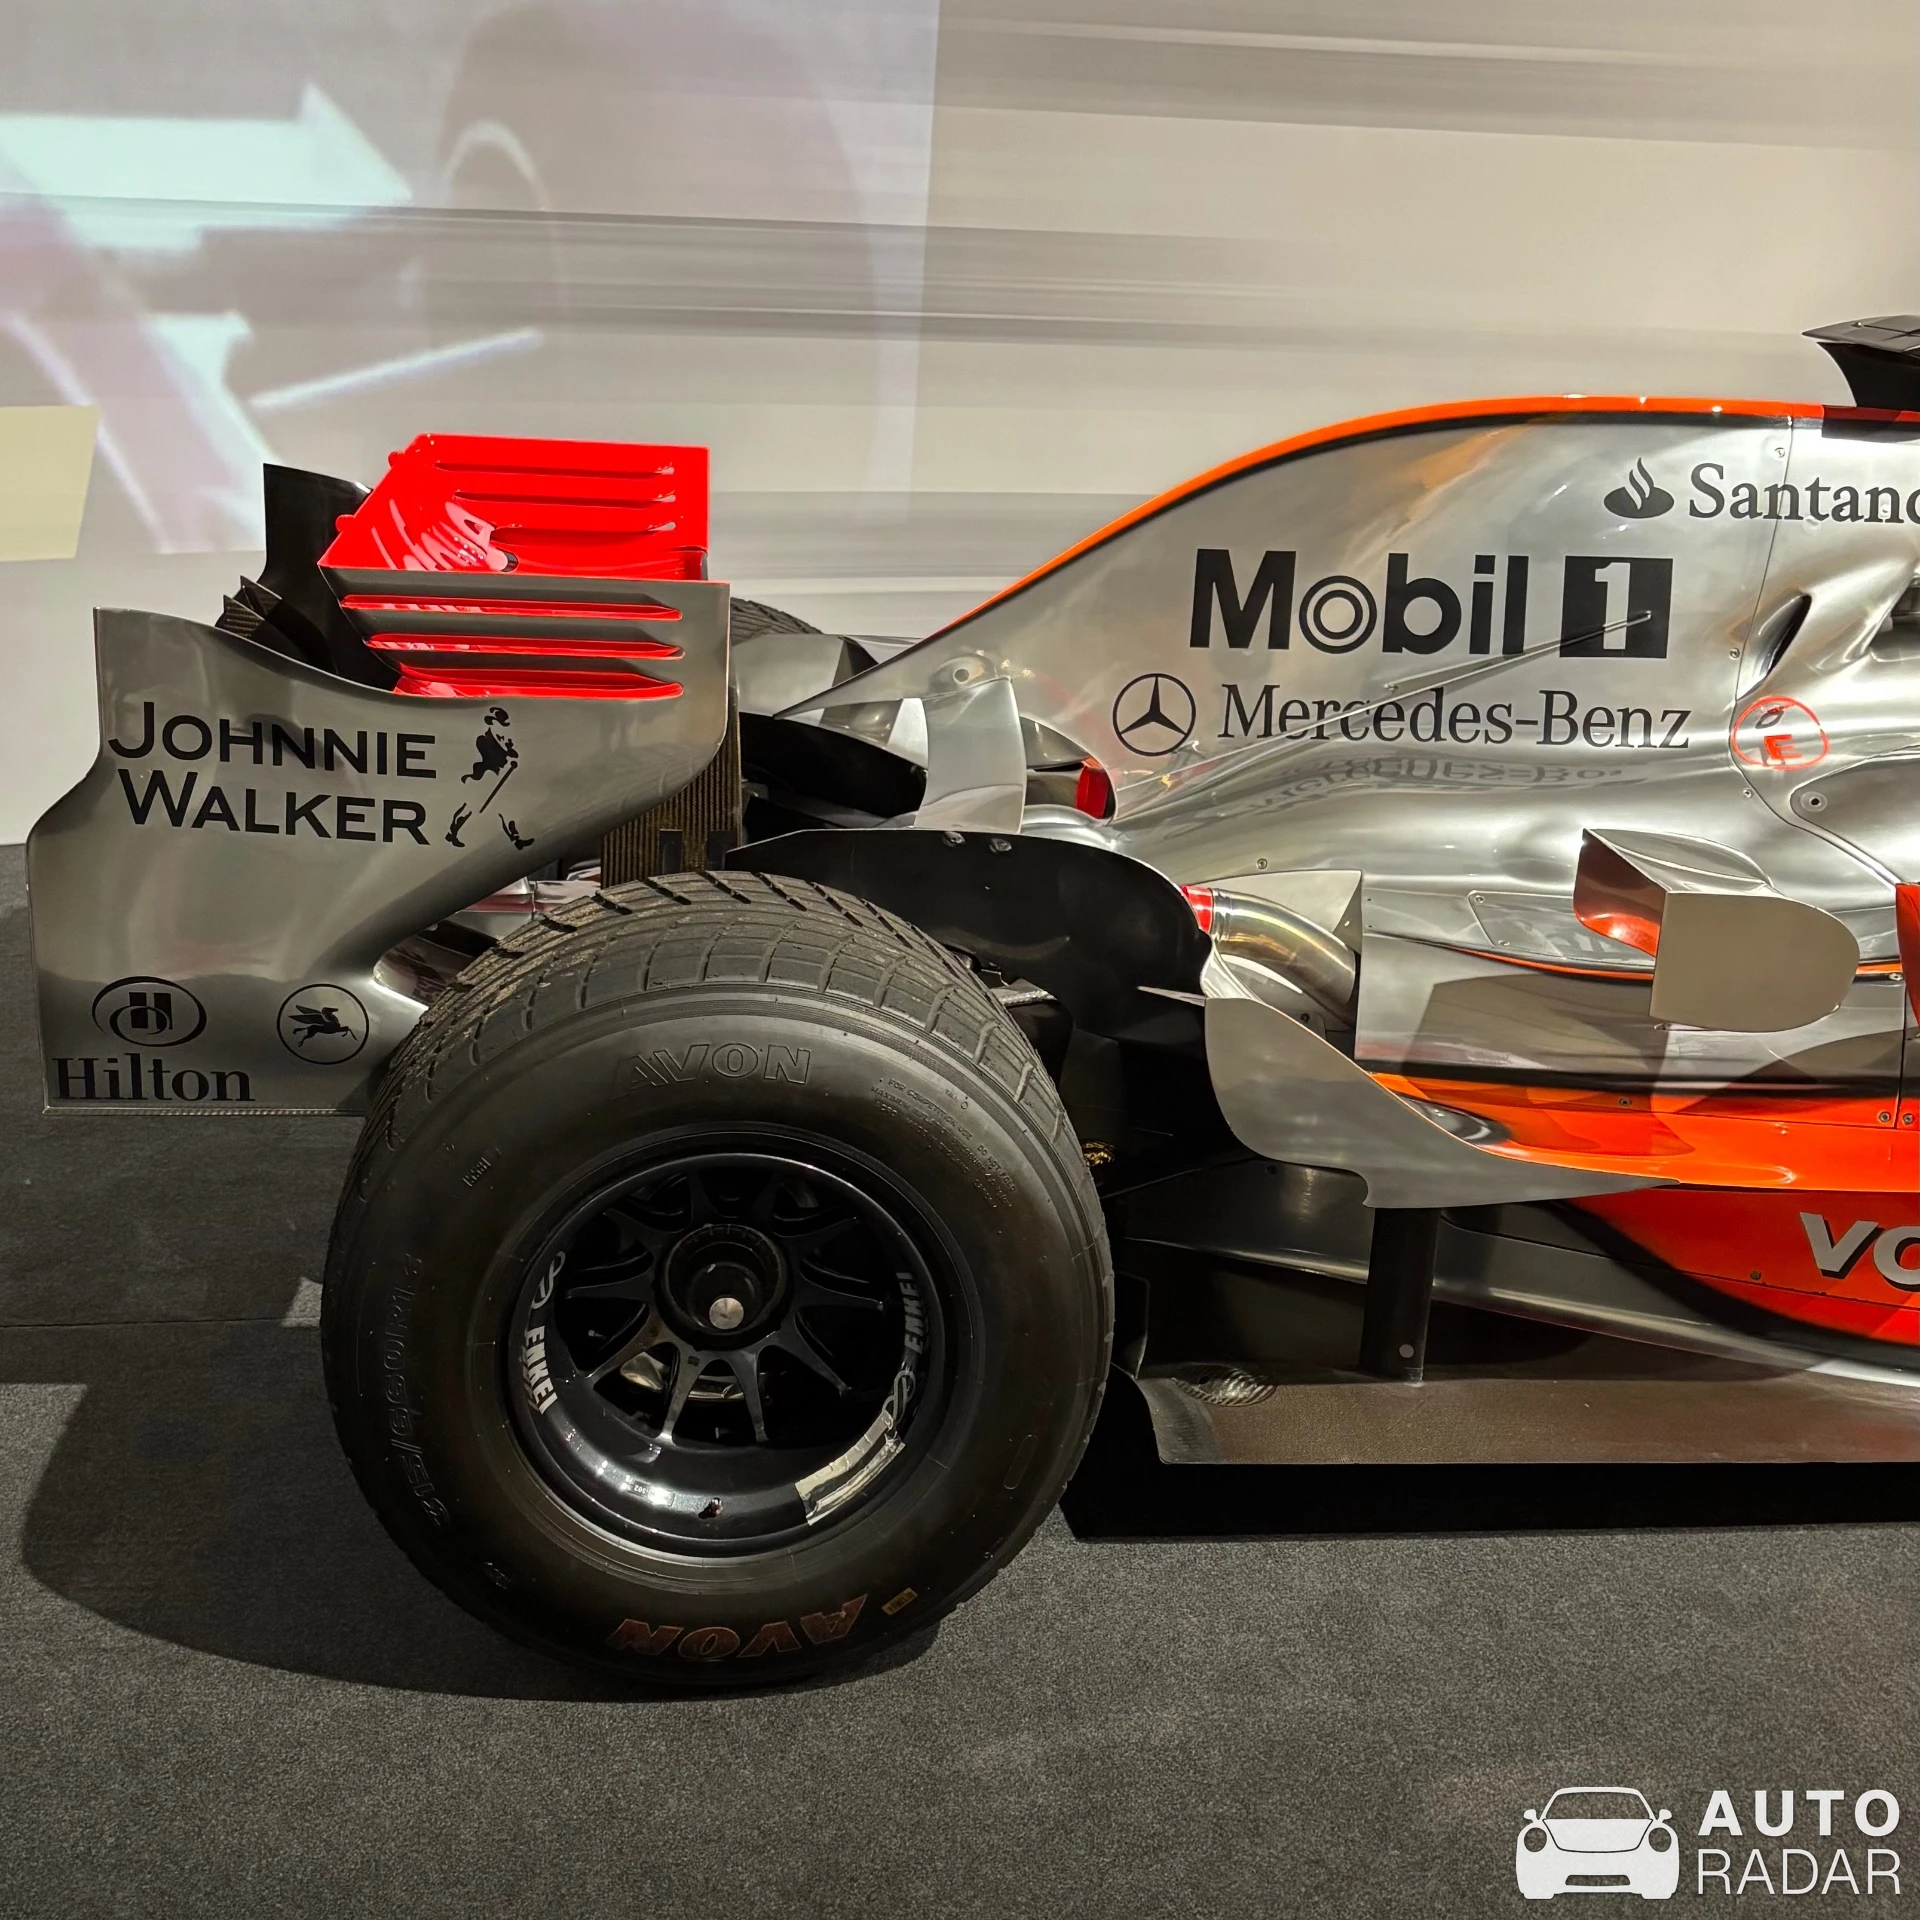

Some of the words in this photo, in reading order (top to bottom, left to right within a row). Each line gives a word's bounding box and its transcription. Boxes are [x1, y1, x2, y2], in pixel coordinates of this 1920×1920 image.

[1190, 548, 1529, 655] Mobil
[108, 702, 436, 778] JOHNNIE
[1219, 683, 1690, 748] Mercedes-Benz
[118, 768, 430, 845] WALKER
[52, 1053, 255, 1102] Hilton
[609, 1043, 811, 1100] AVON
[896, 1272, 924, 1356] ENKEI
[524, 1325, 559, 1414] ENKEI
[605, 1594, 868, 1660] AVON
